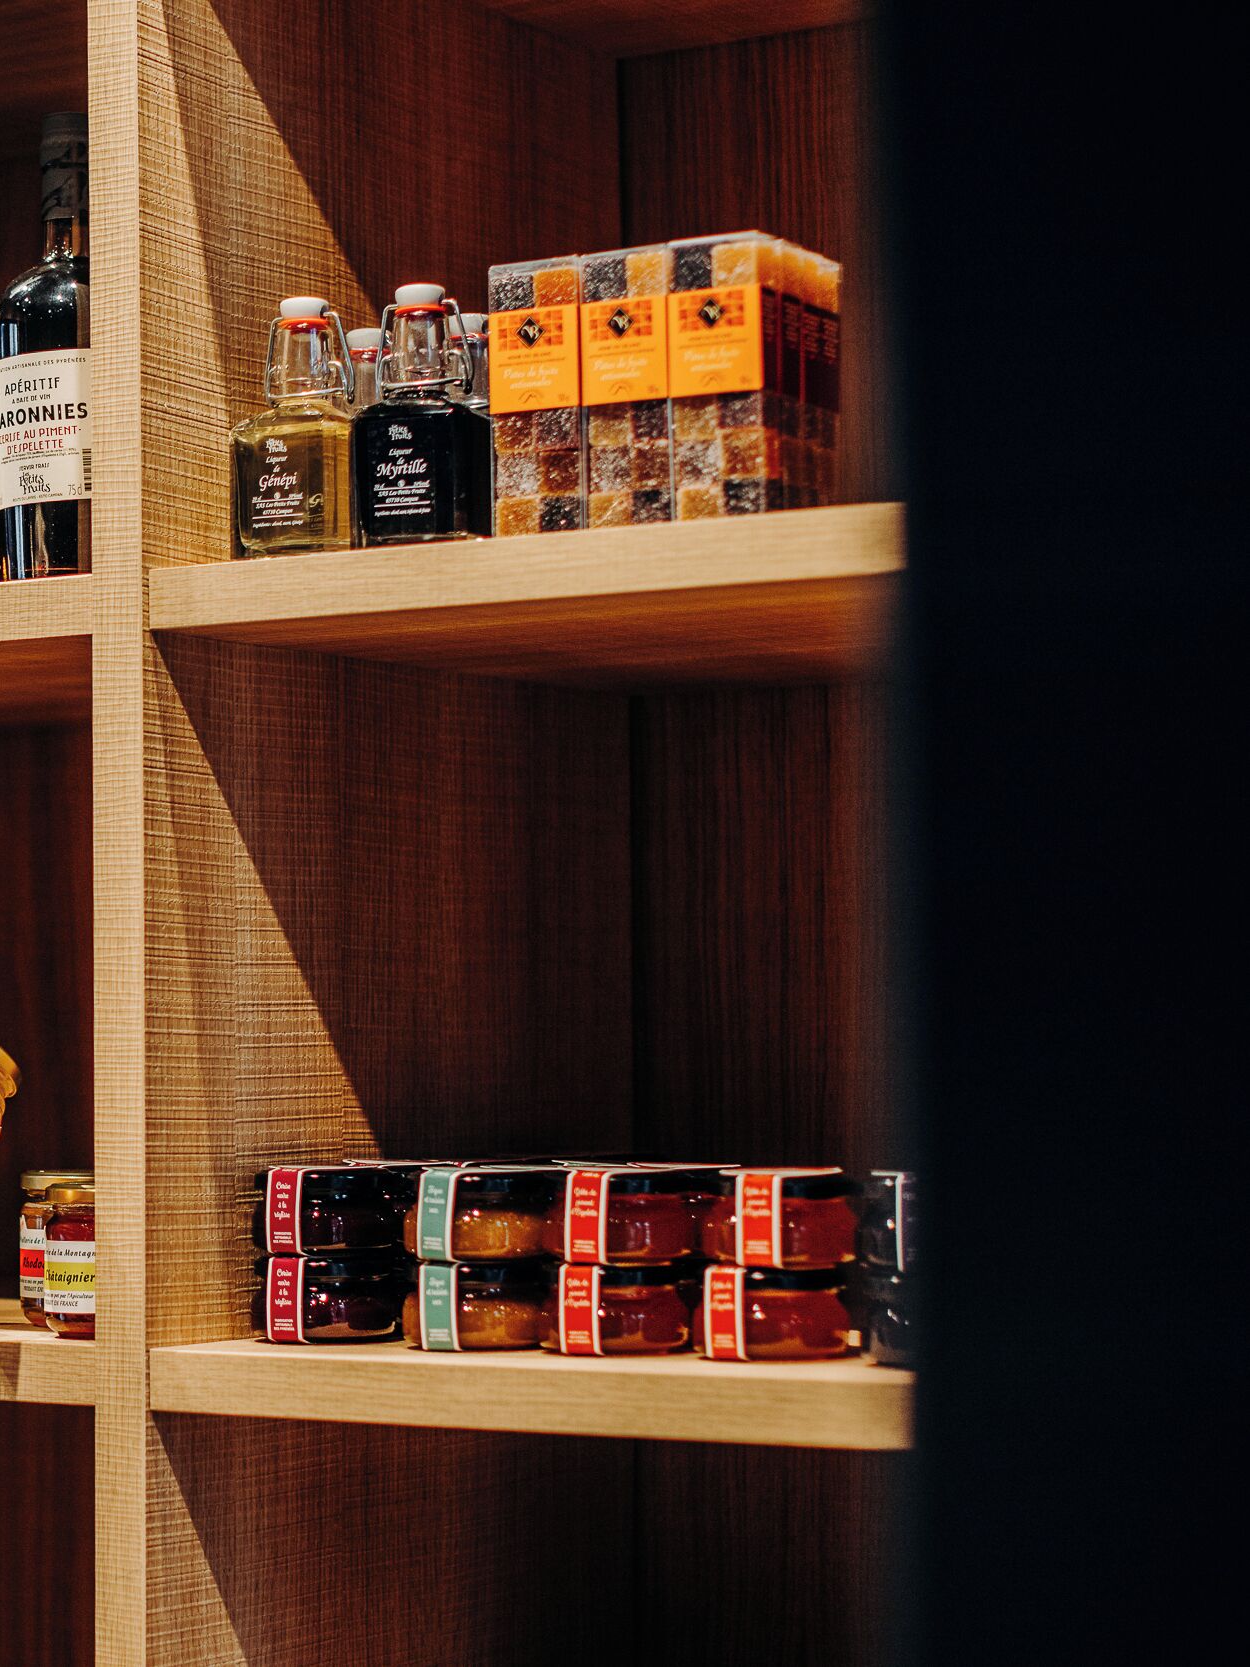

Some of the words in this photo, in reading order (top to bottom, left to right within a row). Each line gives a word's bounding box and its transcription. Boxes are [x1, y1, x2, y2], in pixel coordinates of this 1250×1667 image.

[12, 361, 41, 369] ARTISANALE
[5, 376, 60, 396] APÉRITIF
[0, 431, 20, 445] CERISE
[23, 429, 36, 440] AU
[7, 438, 64, 455] D'ESPELETTE
[388, 447, 414, 457] Liqueur
[376, 458, 428, 480] Myrtille
[18, 474, 44, 487] Petits
[259, 471, 298, 491] Génépi
[22, 483, 51, 495] Fruits
[275, 1181, 291, 1190] Cerise
[46, 1269, 95, 1286] Châtaignier
[276, 1268, 292, 1277] Cerise
[59, 1300, 78, 1308] FRANCE
